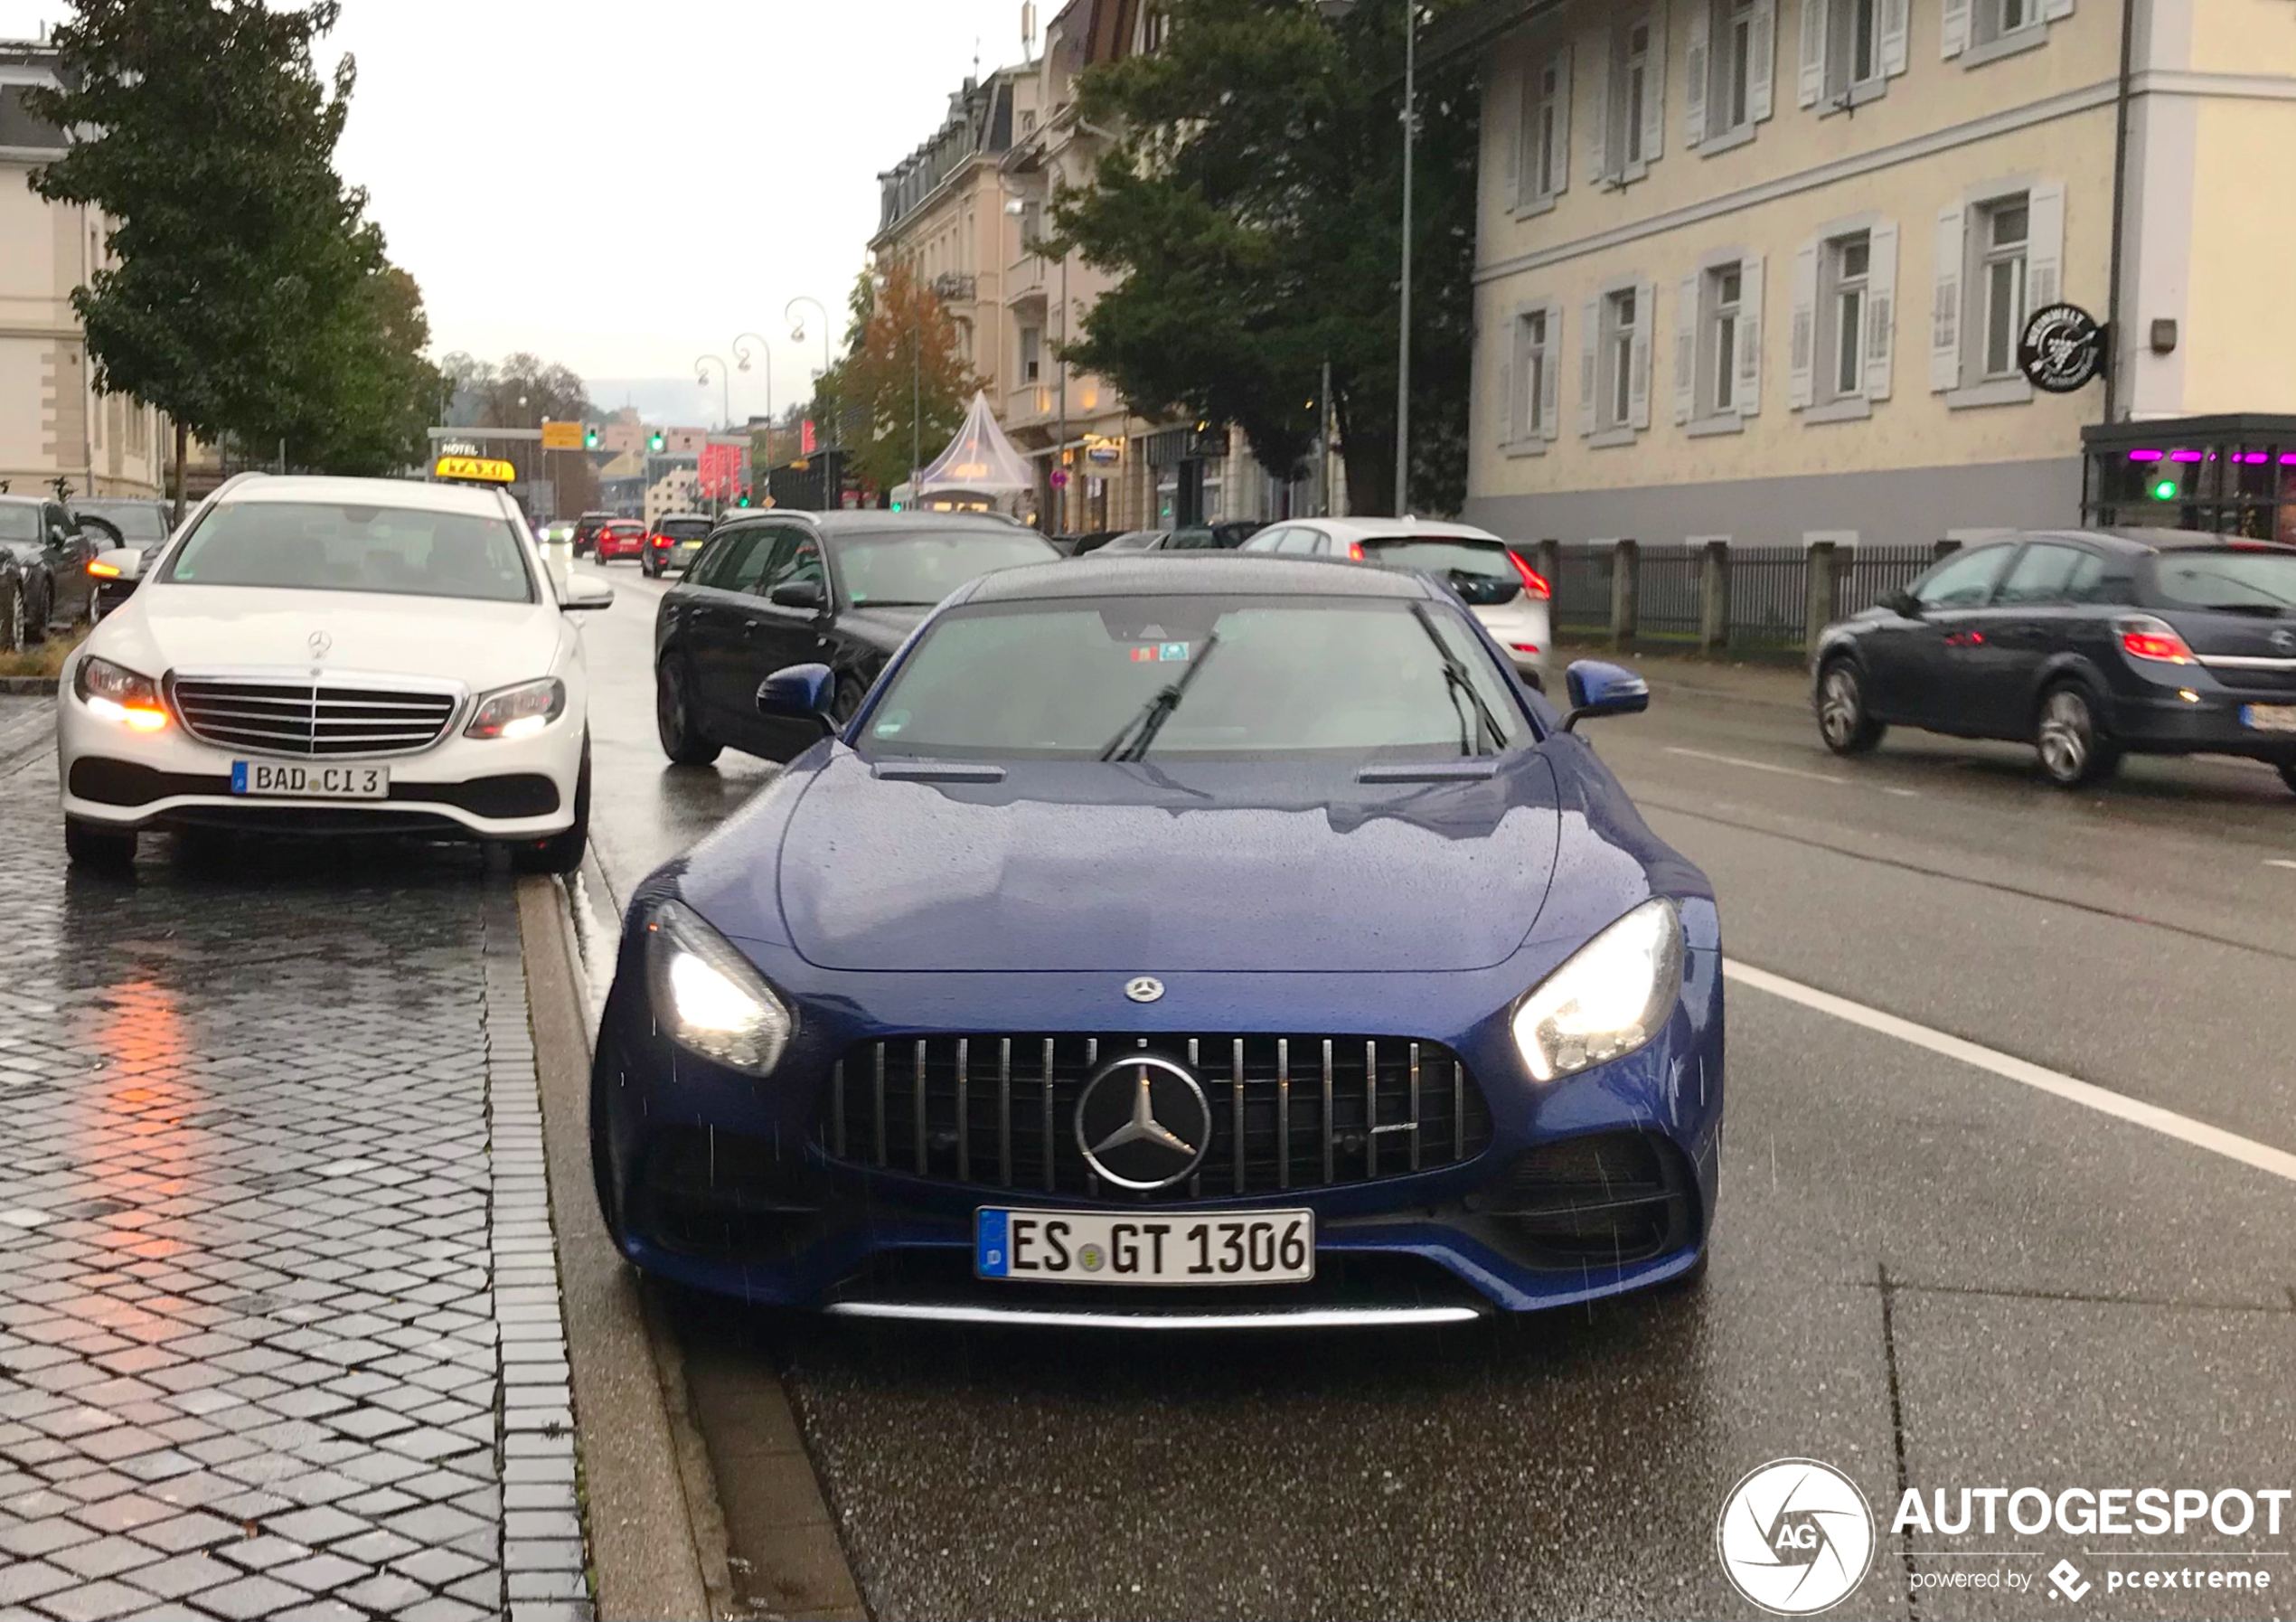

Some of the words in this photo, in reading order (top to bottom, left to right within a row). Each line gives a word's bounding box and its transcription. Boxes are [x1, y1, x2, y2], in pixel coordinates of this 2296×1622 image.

[442, 443, 478, 457] HOTEL
[450, 459, 502, 478] TAXI
[257, 766, 306, 790] BAD
[362, 770, 377, 793] 3
[1012, 1219, 1071, 1271] ES
[1111, 1223, 1170, 1274] GT
[1187, 1221, 1305, 1274] 1306
